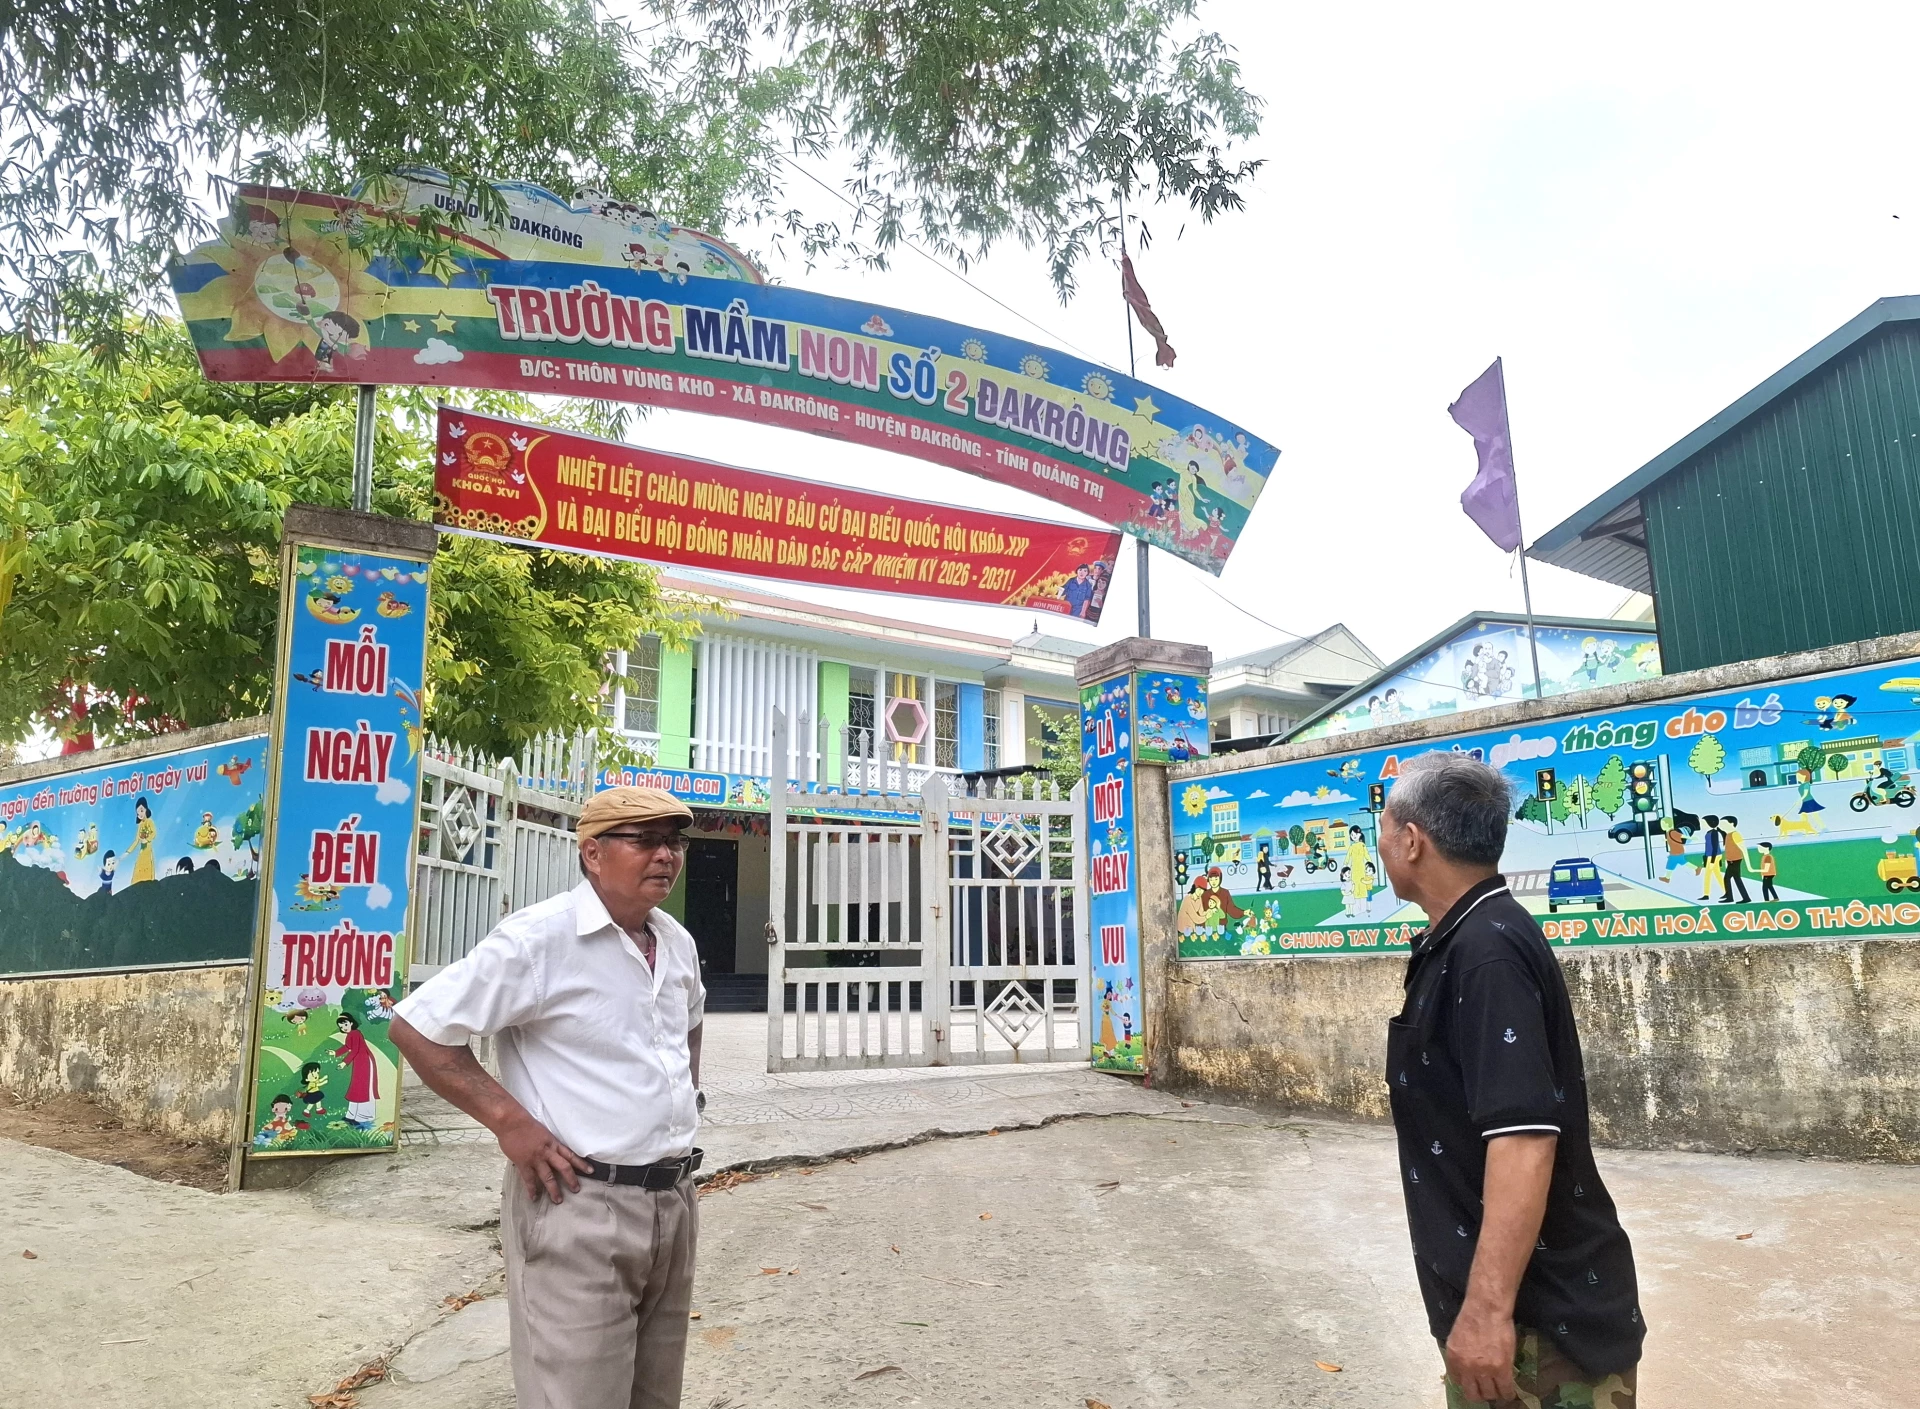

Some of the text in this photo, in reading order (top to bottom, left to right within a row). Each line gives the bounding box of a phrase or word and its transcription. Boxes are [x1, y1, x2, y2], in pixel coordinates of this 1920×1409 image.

[434, 193, 478, 218] UBND
[510, 215, 582, 248] ĐAKRÔNG
[490, 281, 1131, 468] TRƯỜNG MẦM NON SỐ 2 ĐAKRÔNG
[520, 358, 560, 379] Đ/C:
[567, 360, 617, 385] THÔN
[622, 364, 673, 392] VÙNG
[679, 376, 715, 398] KHO
[732, 380, 756, 406] XÃ
[760, 391, 839, 422] ĐAKRÔNG
[855, 410, 906, 438] HUYỆN
[911, 424, 982, 458] ĐAKRÔNG
[996, 446, 1028, 473] TỈNH
[1033, 461, 1080, 490] QUẢNG
[1083, 478, 1104, 501] TRỊ
[496, 486, 520, 499] XVI
[557, 454, 607, 496] NHIỆT
[609, 463, 643, 503] LIỆT
[646, 469, 689, 507] CHÀO
[693, 481, 739, 516] MỪNG
[743, 488, 783, 522] NGÀY
[786, 493, 815, 530] BẦU
[818, 497, 840, 533] CỬ
[841, 509, 865, 543] ĐẠI
[868, 505, 901, 543] BIỂU
[903, 513, 940, 549] QUỐC
[943, 522, 966, 556] HỘI
[969, 527, 1004, 555] KHÓA
[557, 497, 578, 532] VÀ
[582, 505, 611, 543] ĐẠI
[614, 503, 651, 545] BIỂU
[655, 517, 682, 555] HỘI
[685, 516, 727, 557] ĐỒNG
[731, 529, 773, 563] NHÂN
[776, 535, 808, 568] DÂN
[810, 542, 841, 571] CÁC
[842, 543, 872, 574] CẤP
[871, 553, 915, 585] NHIỆM
[937, 561, 970, 589] 2026
[978, 566, 1017, 593] 2031!
[325, 626, 388, 695] MỖI
[306, 722, 394, 784] NGÀY
[1097, 709, 1115, 758] LÀ
[1490, 734, 1556, 767] giao
[1563, 721, 1656, 754] thông
[1664, 707, 1727, 738] cho
[1734, 694, 1783, 729] bé
[0, 760, 208, 819] ngày đến trường là một ngày vui
[636, 771, 671, 791] CHÁU
[675, 774, 690, 792] LÀ
[694, 778, 719, 795] CON
[1094, 775, 1122, 827] MỘT
[1214, 803, 1236, 811] MARKET
[311, 816, 378, 885] ĐẾN
[1092, 846, 1128, 893] NGÀY
[1100, 925, 1126, 965] VUI
[1279, 931, 1344, 949] CHUNG
[1348, 928, 1380, 946] TAY
[1544, 900, 1920, 944] ĐẸP VĂN HOÁ GIAO THÔNG
[281, 919, 394, 988] TRƯỜNG
